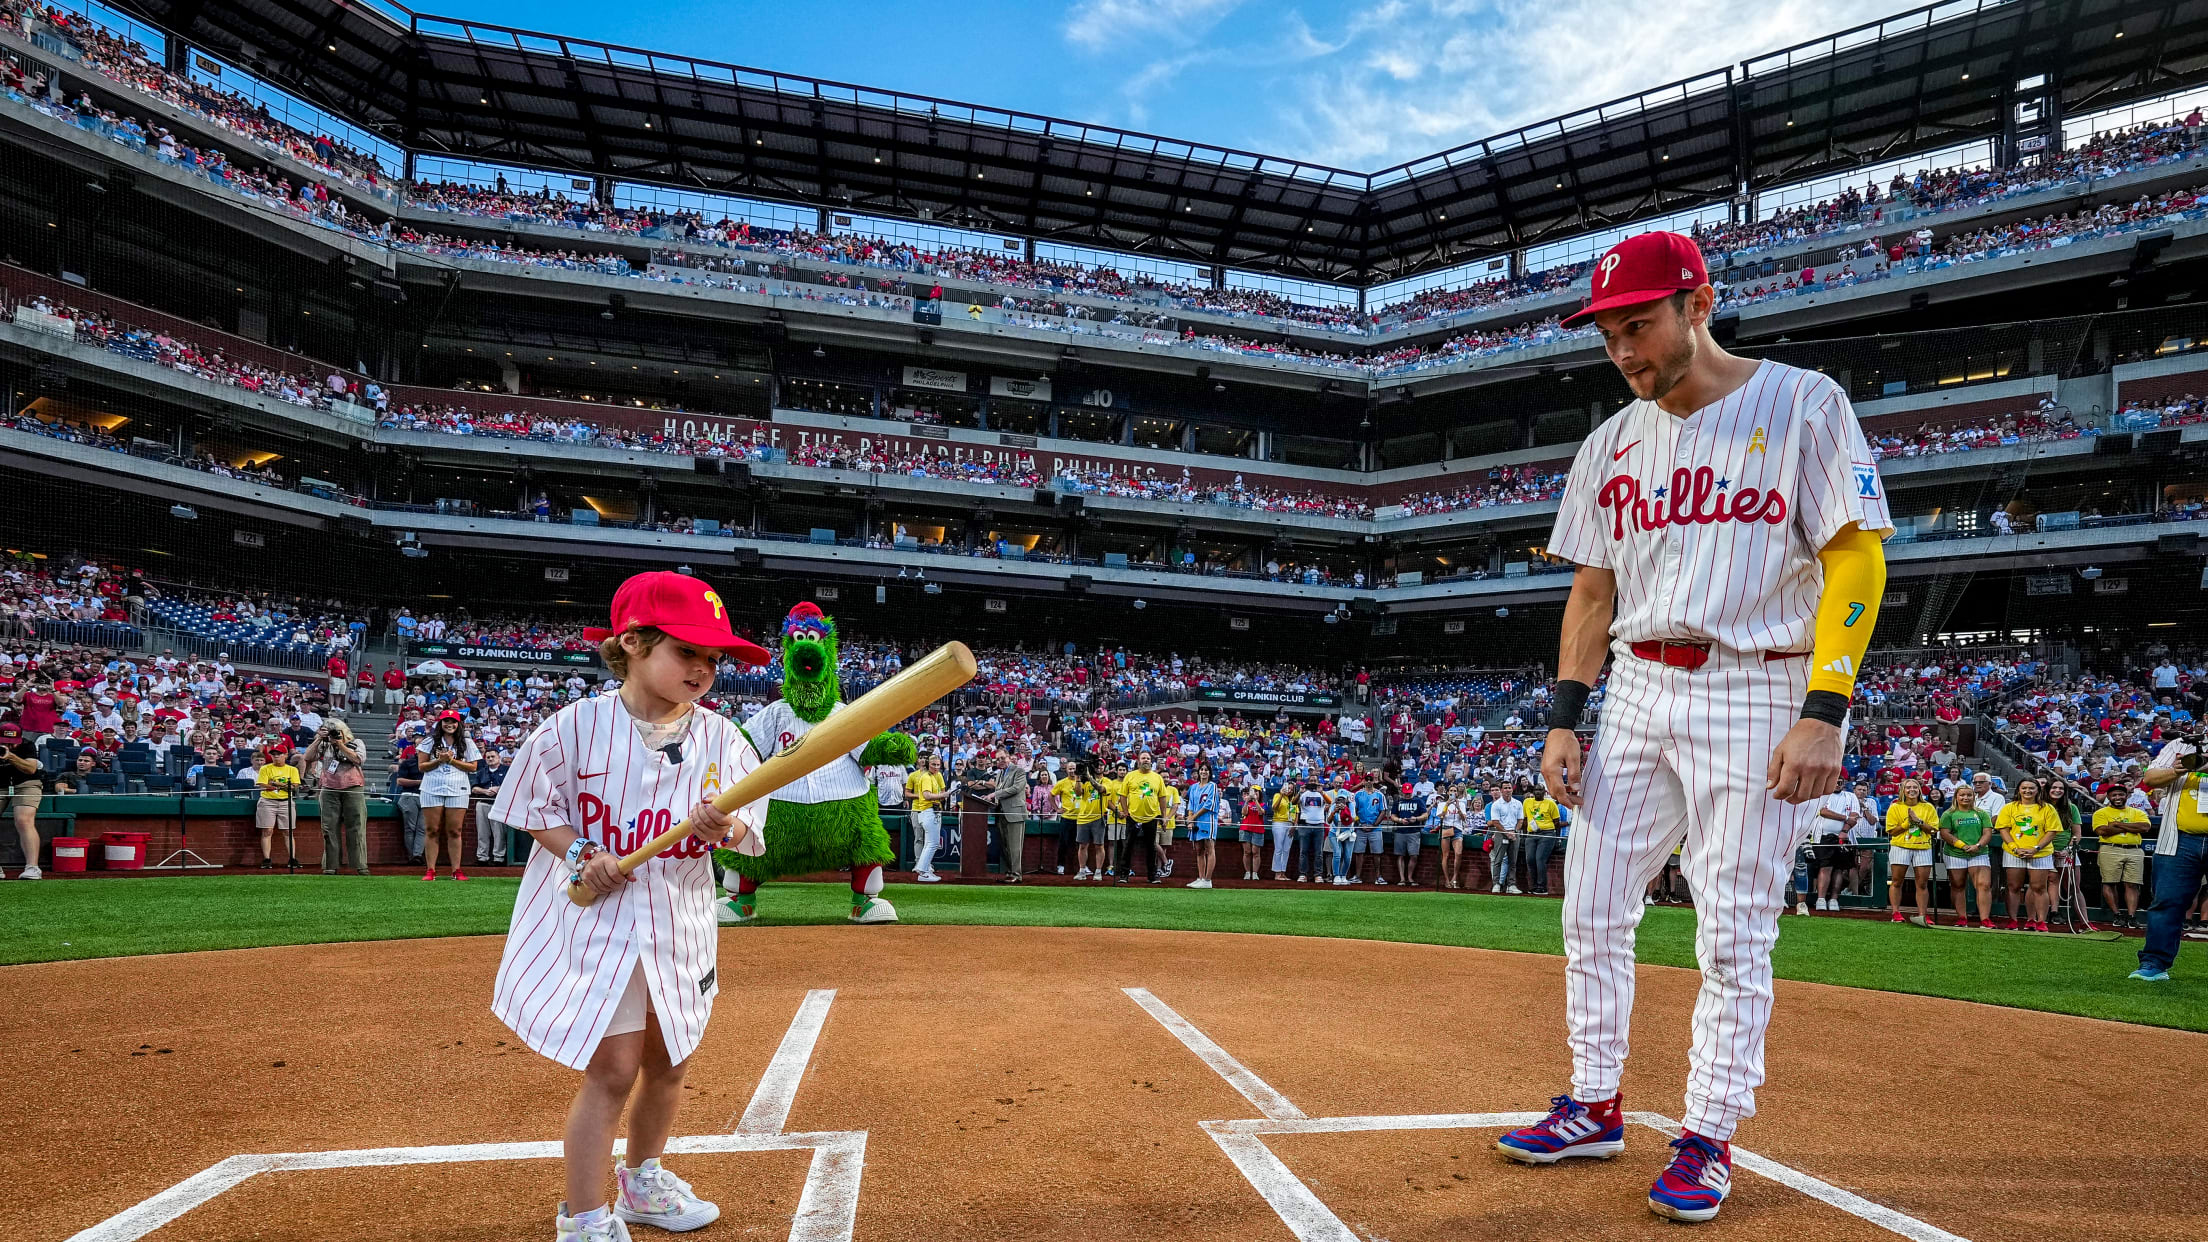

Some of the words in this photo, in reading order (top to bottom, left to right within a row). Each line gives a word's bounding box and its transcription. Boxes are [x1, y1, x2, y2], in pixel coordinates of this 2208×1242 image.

[1601, 253, 1621, 288] P
[1093, 390, 1112, 407] 10
[664, 418, 736, 439] HOME
[1855, 473, 1877, 496] X
[1598, 466, 1787, 541] Phillies
[2103, 579, 2120, 590] 129
[704, 591, 723, 619] P
[1844, 602, 1865, 627] 7
[458, 647, 475, 656] CP
[476, 648, 518, 658] RANKIN
[519, 650, 552, 660] CLUB
[1234, 691, 1247, 699] CP
[1247, 692, 1279, 701] RANKIN
[1280, 694, 1305, 703] CLUB
[1372, 798, 1380, 807] P
[577, 792, 707, 860] Phillie
[950, 829, 992, 846] MB
